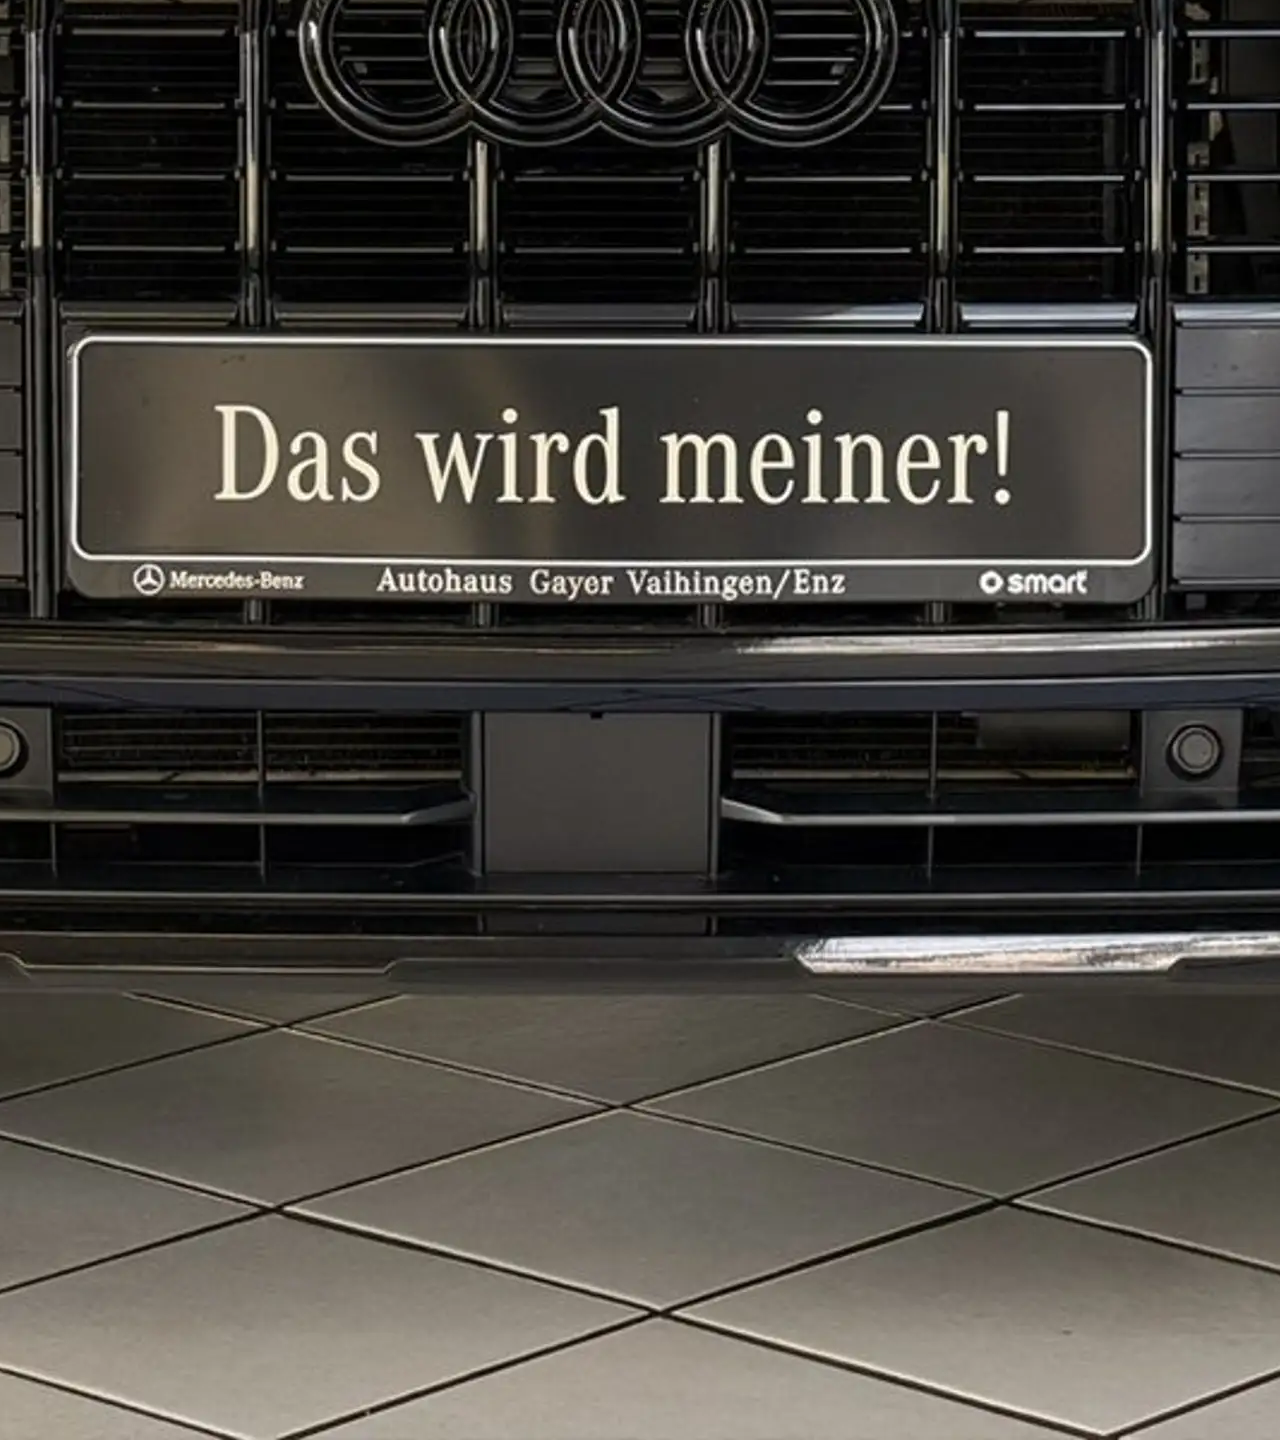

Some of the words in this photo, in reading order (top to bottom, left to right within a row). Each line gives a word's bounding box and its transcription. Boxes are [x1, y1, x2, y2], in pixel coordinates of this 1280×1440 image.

[213, 404, 381, 503] Das
[415, 406, 626, 506] wird
[658, 408, 1012, 506] meiner!
[169, 570, 306, 590] Mercedes-Benz
[375, 567, 514, 594] Autohaus
[529, 569, 615, 601] Gayer
[626, 568, 847, 602] Vaihingen/Enz
[1007, 570, 1088, 595] smart
